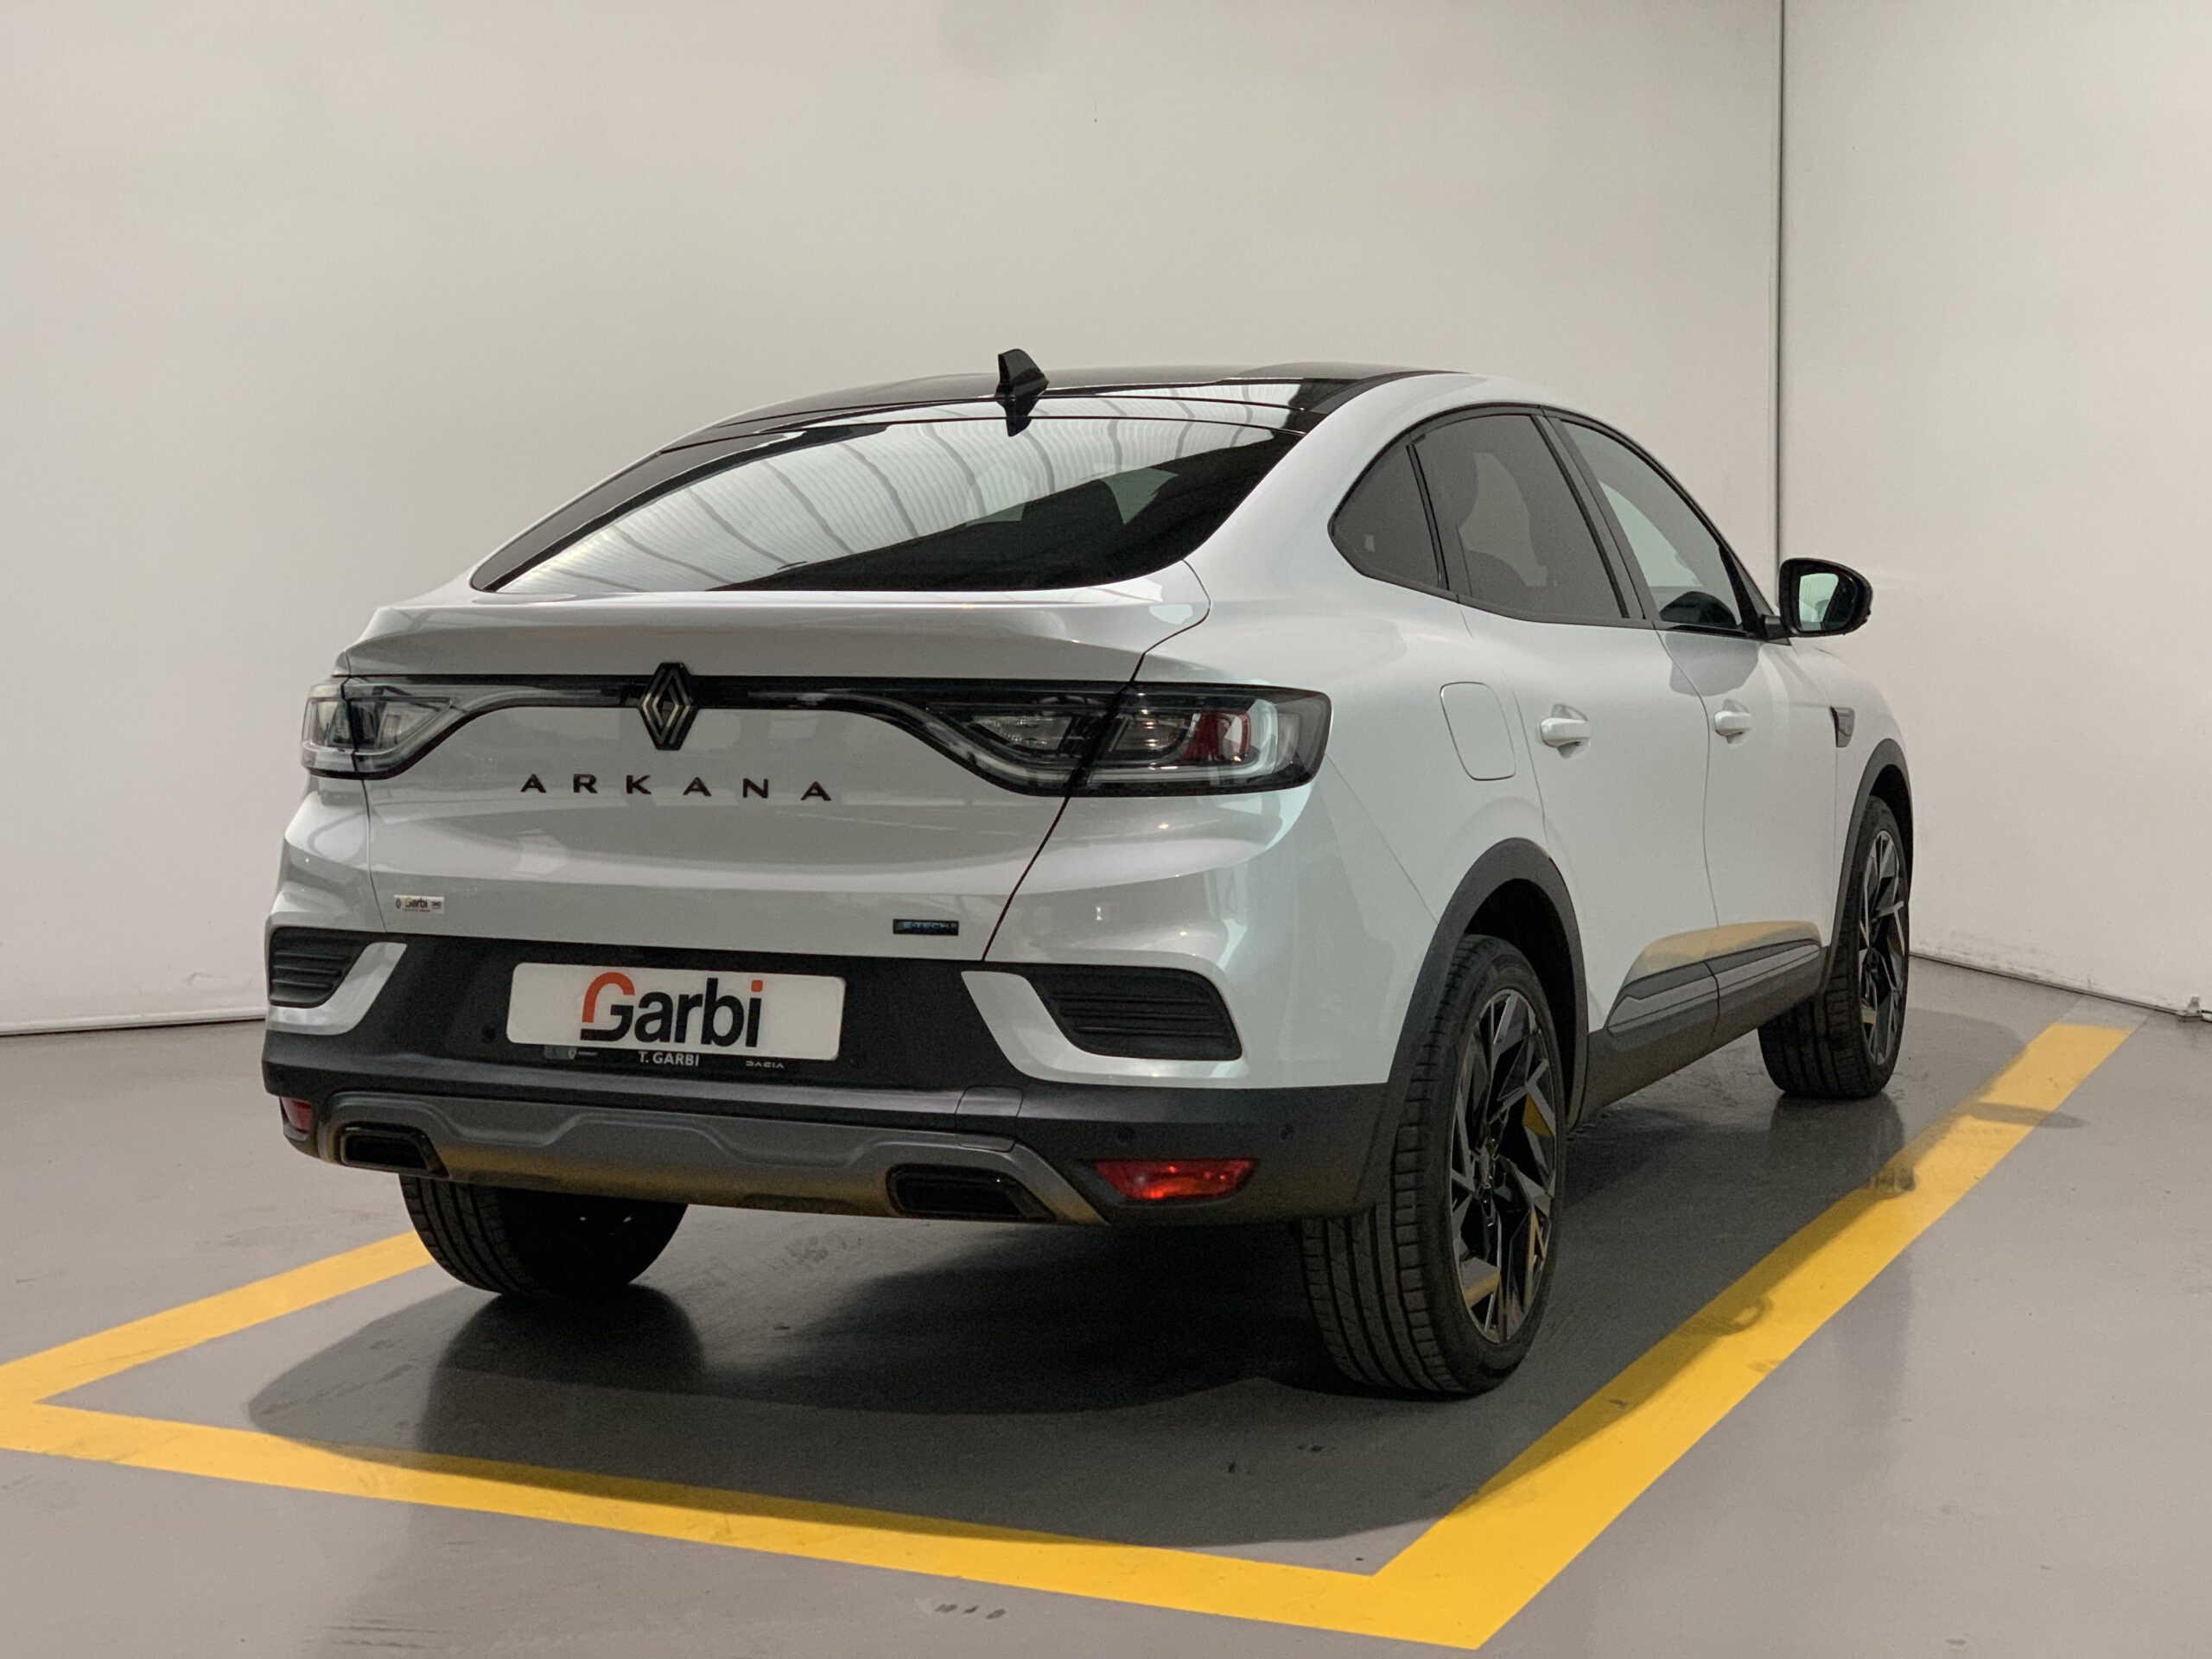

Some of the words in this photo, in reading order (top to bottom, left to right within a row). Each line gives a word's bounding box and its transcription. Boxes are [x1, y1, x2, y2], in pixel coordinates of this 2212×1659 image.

[520, 773, 832, 802] ARKANA
[580, 971, 763, 1048] Garbi
[639, 1052, 650, 1065] T.
[653, 1052, 700, 1067] GARBI
[746, 1060, 785, 1069] DACIA
